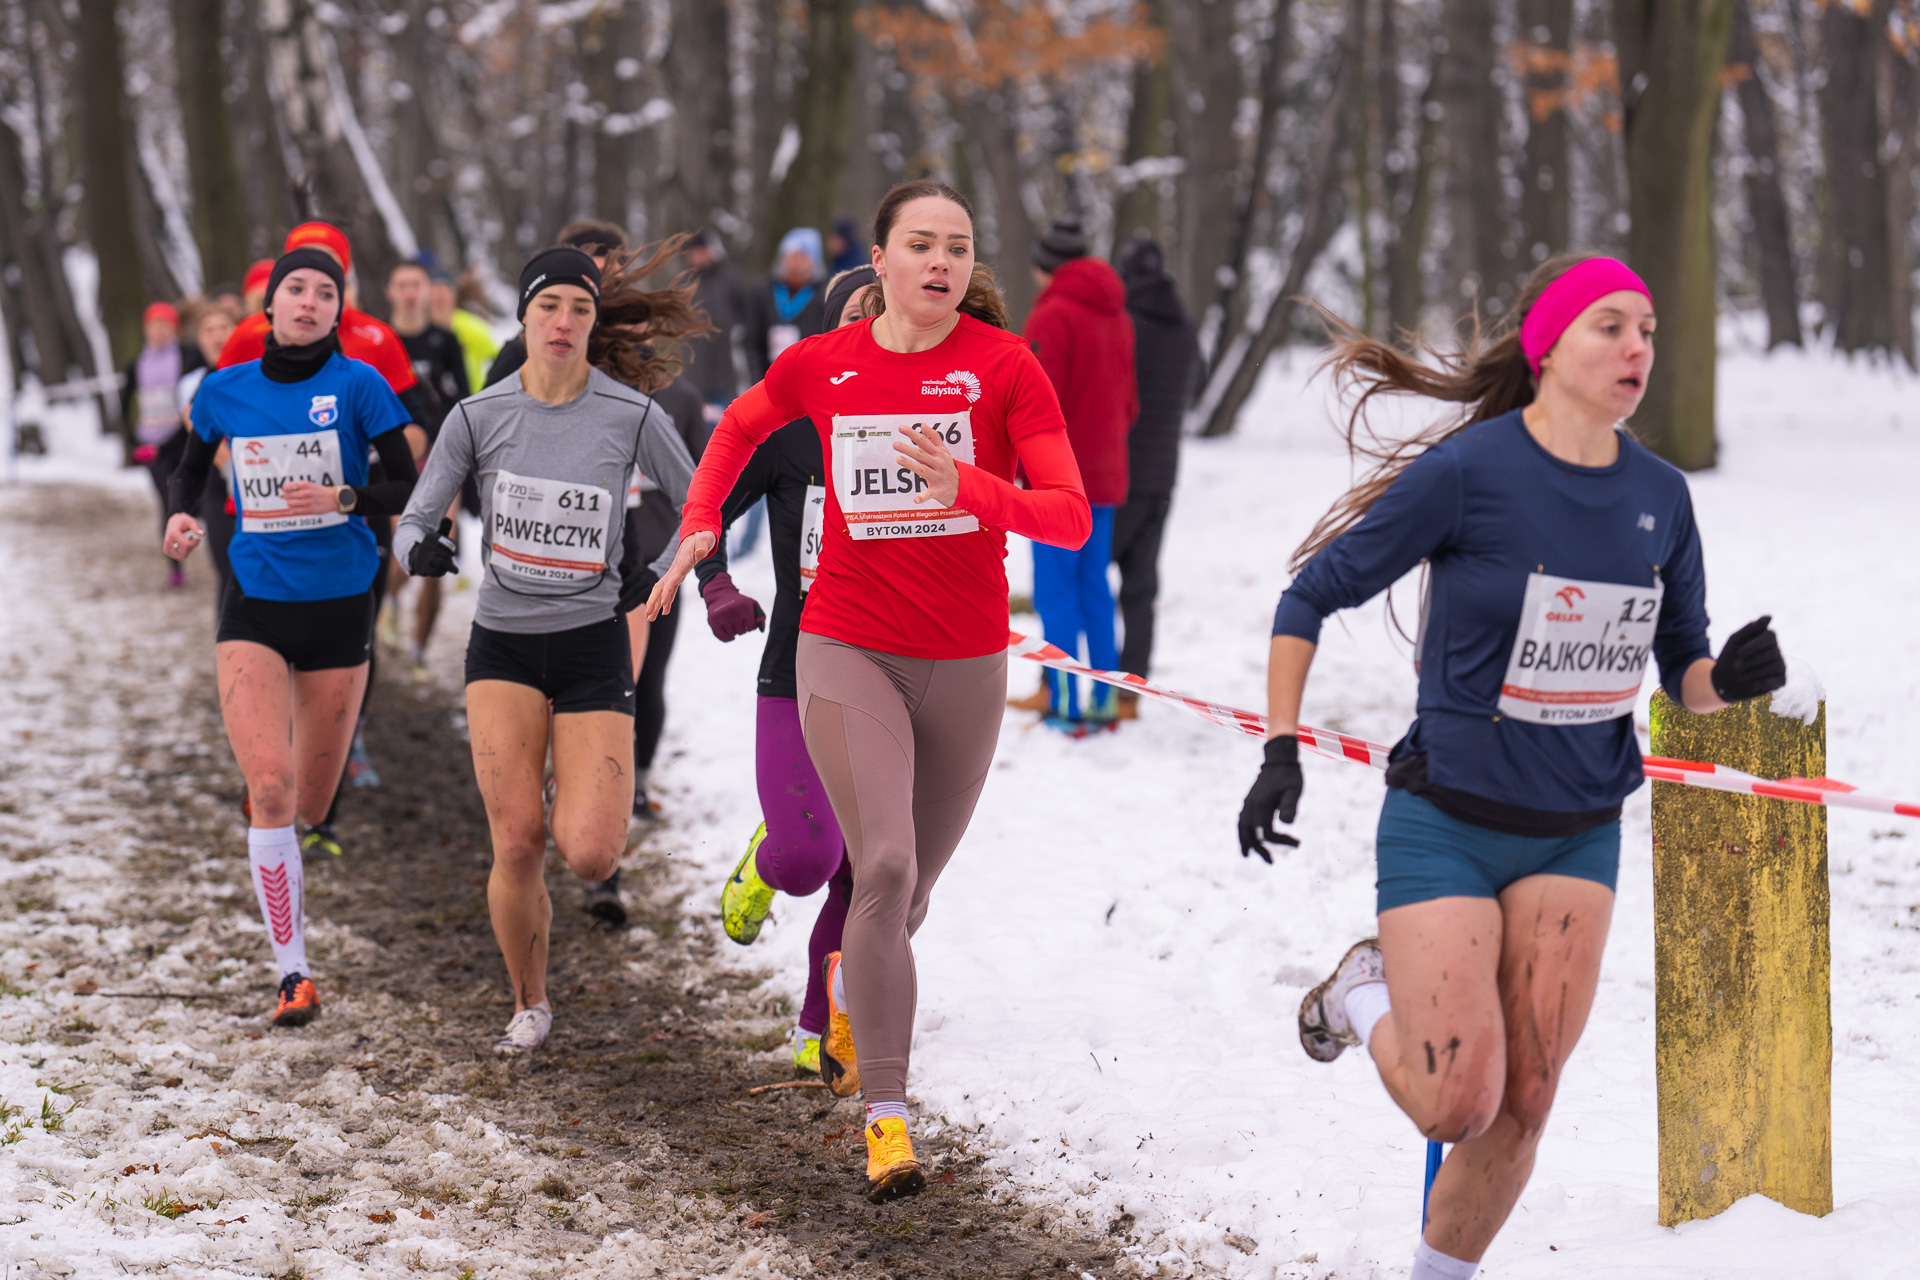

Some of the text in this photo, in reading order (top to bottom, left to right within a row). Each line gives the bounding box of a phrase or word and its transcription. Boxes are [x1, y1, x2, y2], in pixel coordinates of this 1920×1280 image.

[921, 385, 962, 397] Białystok
[296, 439, 322, 458] 44
[508, 481, 527, 496] 770
[850, 467, 929, 496] JELSK
[558, 489, 600, 511] 611
[916, 511, 939, 519] Biegach
[263, 520, 297, 529] BYTOM
[495, 512, 603, 549] PAWEŁCZYK
[866, 523, 946, 536] BYTOM 2024
[511, 562, 547, 577] BYTOM
[549, 569, 575, 580] 2024
[1545, 611, 1584, 623] ORLEN
[1619, 597, 1656, 623] 12
[1517, 638, 1649, 673] BAJKOWSK
[1539, 707, 1586, 720] BYTOM
